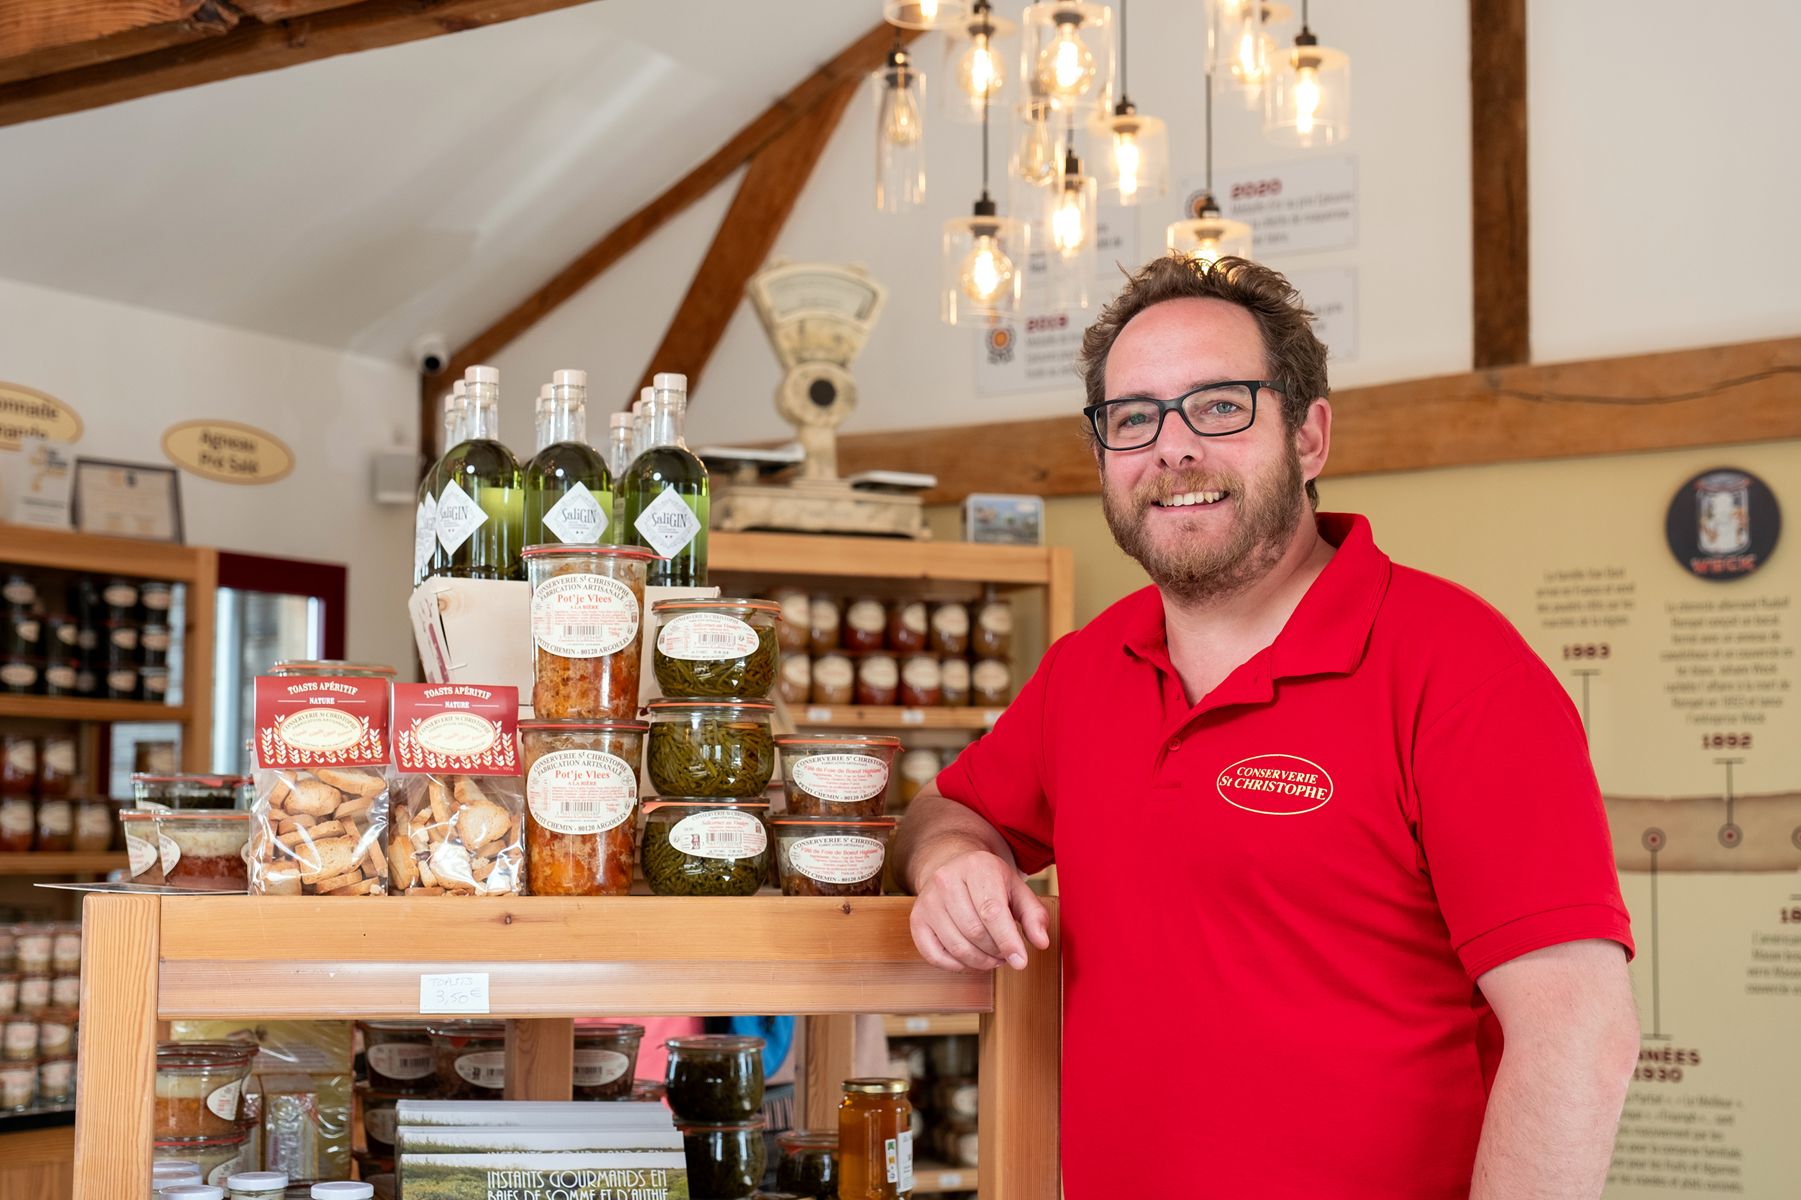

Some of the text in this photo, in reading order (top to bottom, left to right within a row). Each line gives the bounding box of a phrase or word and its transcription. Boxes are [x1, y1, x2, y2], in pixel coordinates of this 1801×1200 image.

[1231, 178, 1282, 200] 2020
[561, 508, 598, 524] SaliGIN
[651, 512, 688, 528] SaliGIN
[1691, 555, 1756, 574] WECK
[536, 576, 578, 598] CONSERVERIE
[588, 576, 630, 598] CHRISTOPHE
[540, 583, 626, 602] FABRICATION ARTISANALE
[587, 593, 613, 604] Vlees
[550, 645, 576, 656] CHEMIN
[580, 648, 599, 656] 80120
[287, 681, 358, 696] TOASTS APÉRITIF
[423, 686, 492, 699] TOASTS APÉRITIF
[309, 697, 335, 705] NATURE
[533, 752, 577, 773] CONSERVERIE
[586, 752, 628, 773] CHRISTOPHE
[537, 760, 623, 777] FABRICATION ARTISANALE
[796, 755, 843, 769] CONSERVERIE
[853, 756, 888, 772] CHRISTOPHE
[586, 770, 610, 779] Vlees
[1236, 766, 1318, 785] CONSERVERIE
[799, 782, 813, 794] PETIT
[813, 791, 839, 800] CHEMIN
[1219, 775, 1328, 801] St CHRISTOPHE
[547, 821, 573, 831] CHEMIN
[578, 824, 595, 832] 80120
[596, 813, 627, 830] ARGOULES
[793, 837, 841, 849] CONSERVERIE
[850, 838, 883, 849] CHRISTOPHE
[795, 863, 811, 876] PETIT
[811, 872, 837, 882] CHEMIN
[1638, 1043, 1702, 1067] NNÉES
[1634, 1066, 1684, 1084] 1930
[487, 1169, 667, 1189] INSTANTS GOURMANDS EN
[487, 1189, 519, 1200] BAIES
[524, 1189, 541, 1200] DE
[545, 1189, 596, 1200] SOMME
